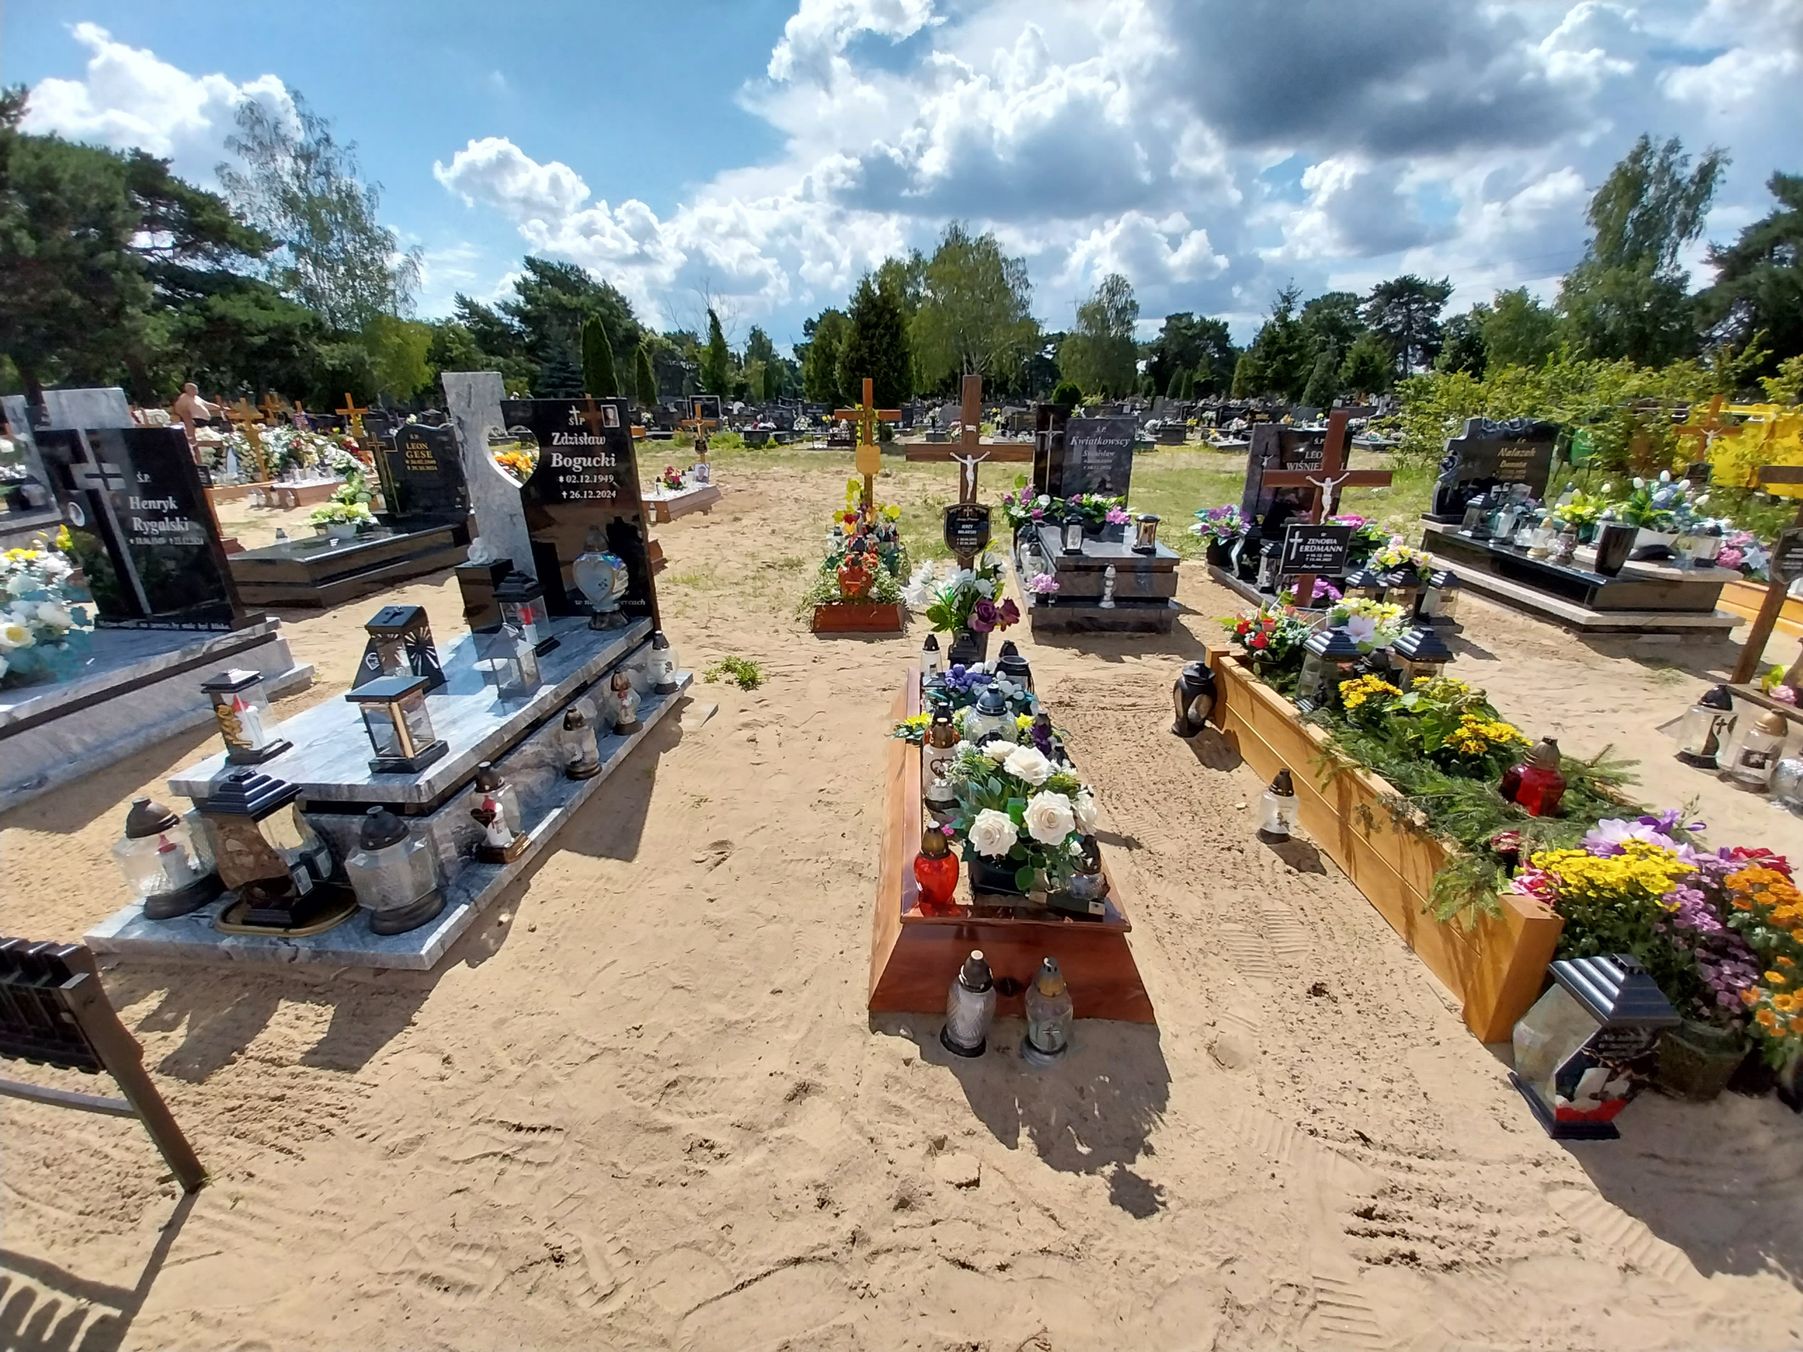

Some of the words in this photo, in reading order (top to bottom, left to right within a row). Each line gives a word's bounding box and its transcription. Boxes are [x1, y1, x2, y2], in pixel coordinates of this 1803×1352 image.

[551, 432, 606, 446] Zdzisław
[1070, 436, 1130, 447] Kwiatkowscy
[406, 442, 429, 450] LEON
[1305, 451, 1324, 459] LEO
[551, 453, 617, 472] Bogucki
[1286, 460, 1345, 470] WIŚNIEI
[566, 475, 615, 483] 02.12.1949
[570, 491, 617, 499] 26.12.2024
[129, 496, 179, 513] Henryk
[132, 517, 190, 535] Rygalski
